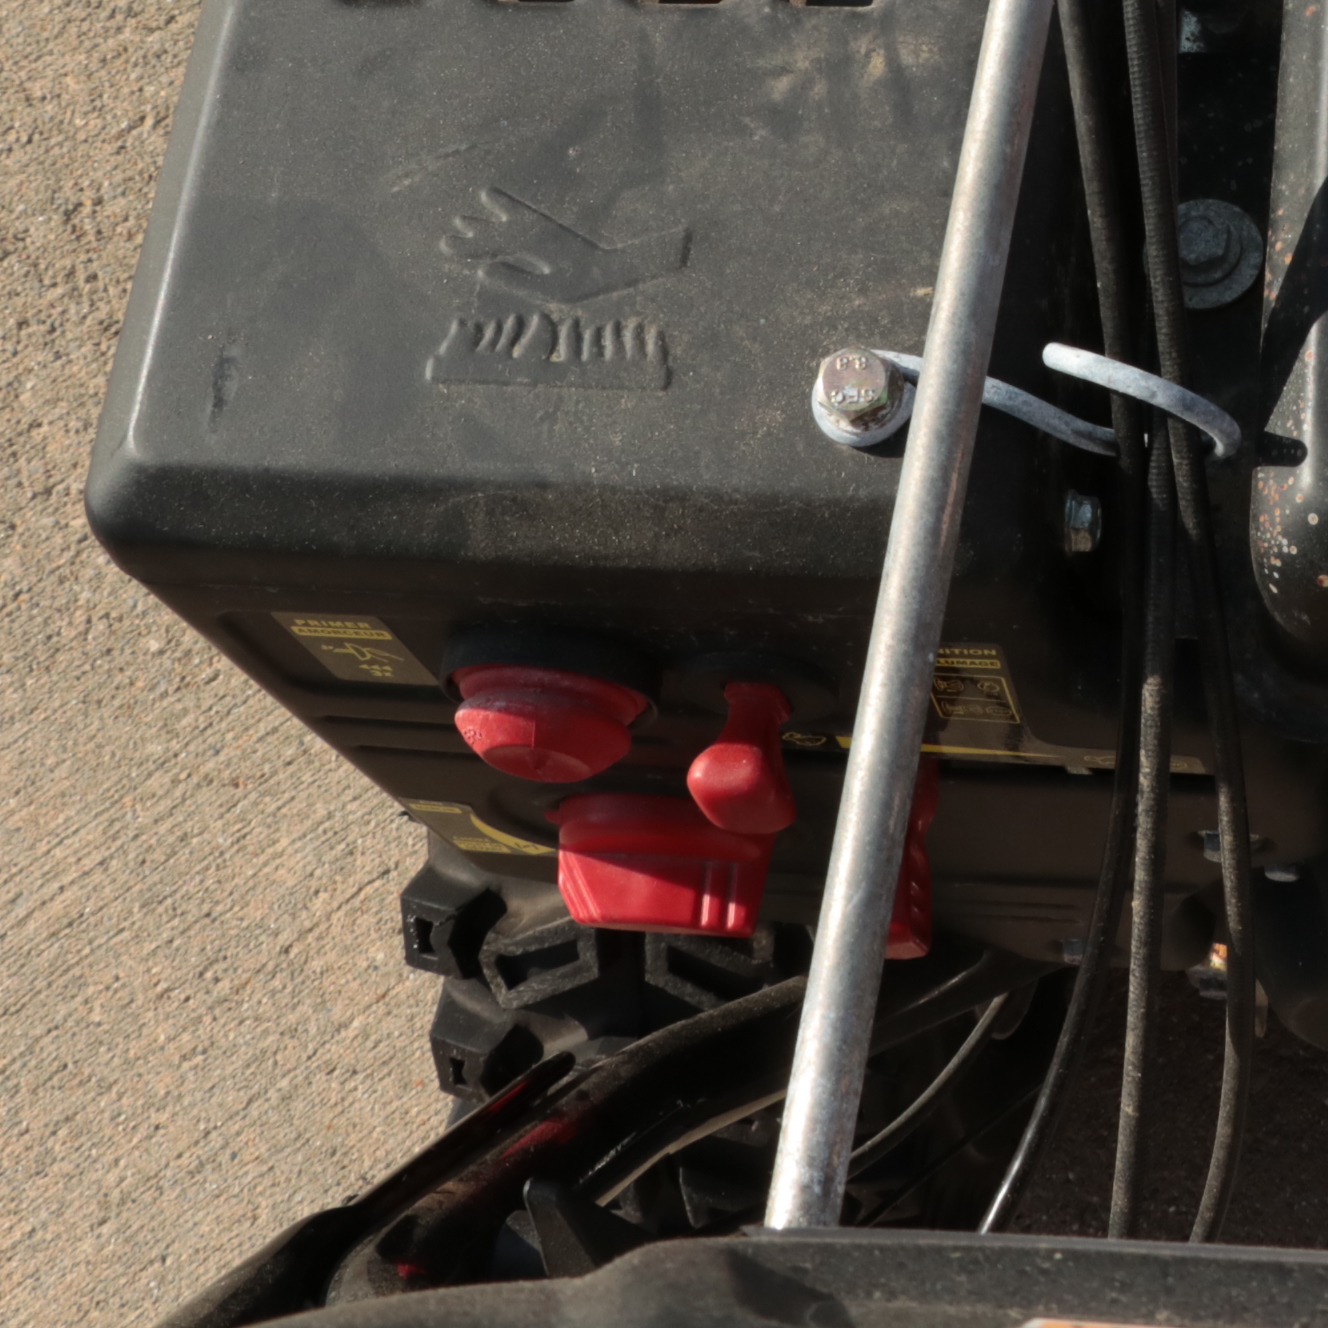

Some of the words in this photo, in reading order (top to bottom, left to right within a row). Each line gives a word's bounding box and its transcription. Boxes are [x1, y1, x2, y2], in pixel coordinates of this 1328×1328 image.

[294, 619, 372, 629] PRIMER
[297, 628, 386, 638] AMORCEUR
[938, 648, 997, 656] ITION
[936, 659, 1000, 668] LUMAGE
